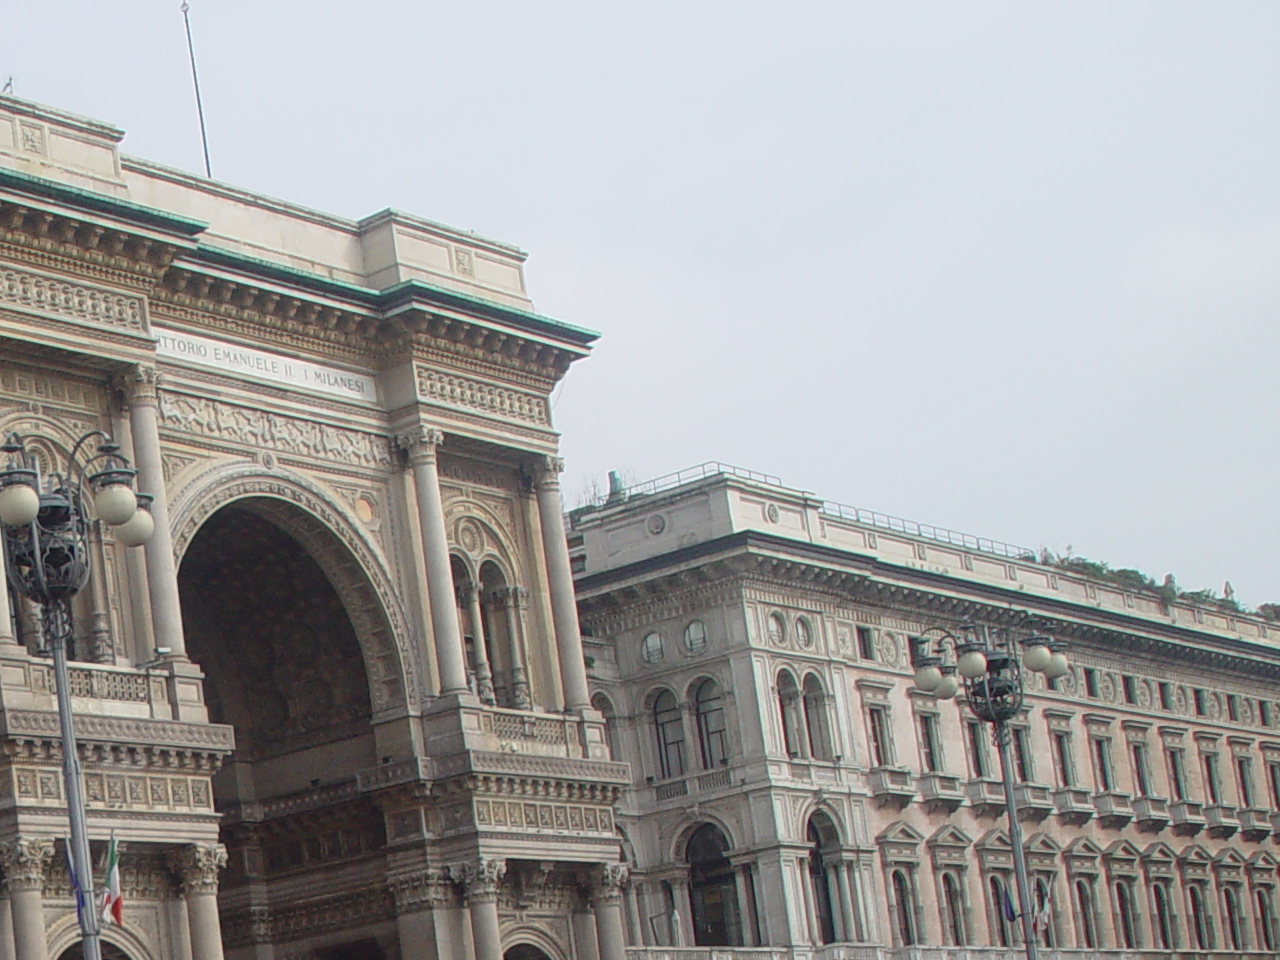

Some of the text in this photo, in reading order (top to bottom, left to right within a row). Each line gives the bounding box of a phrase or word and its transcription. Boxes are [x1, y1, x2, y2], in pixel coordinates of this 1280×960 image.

[155, 334, 208, 357] ITTORIO
[214, 347, 279, 374] EMANUELE
[314, 370, 365, 393] MILANESI
